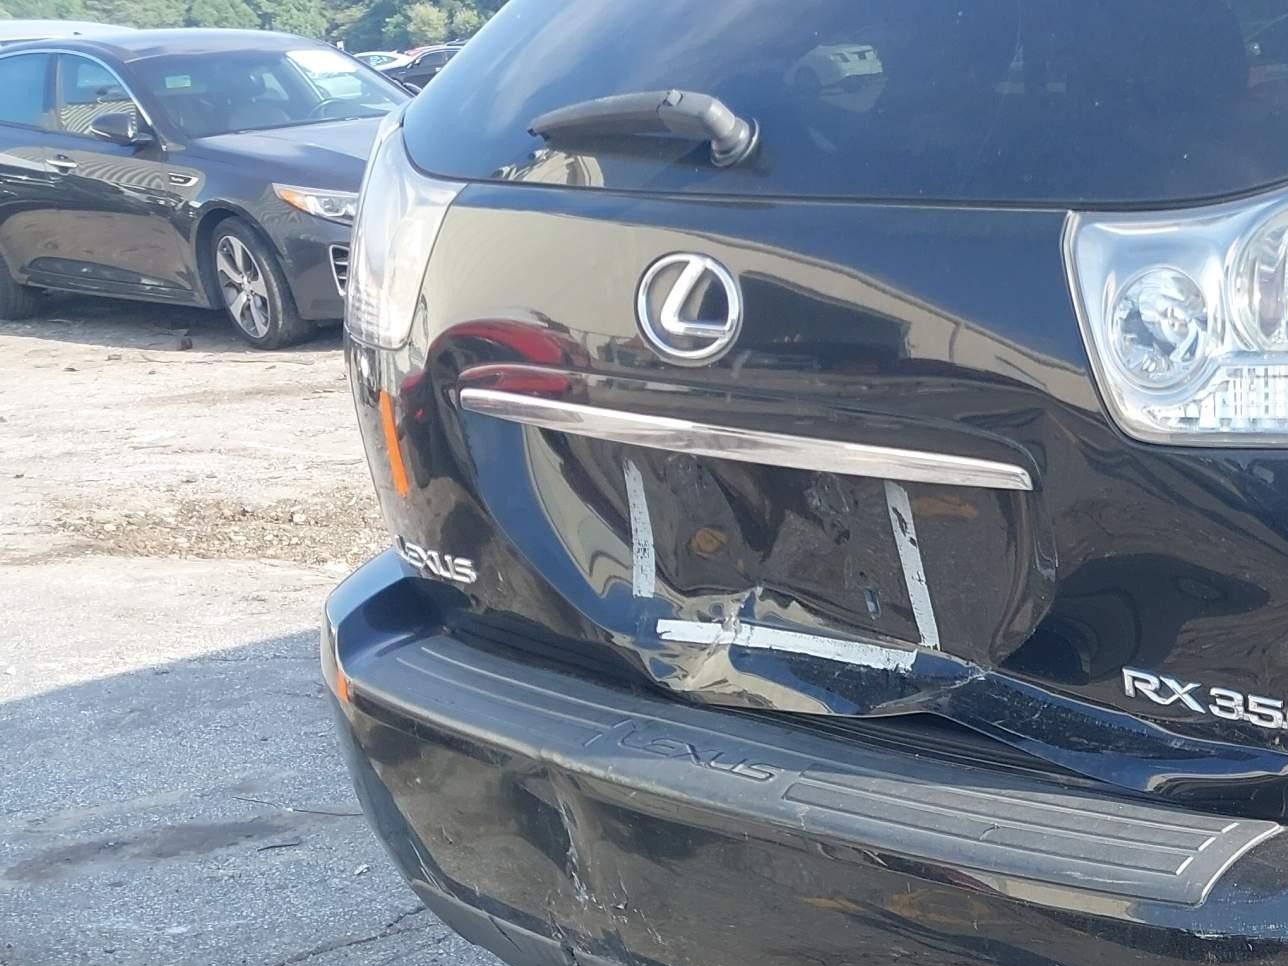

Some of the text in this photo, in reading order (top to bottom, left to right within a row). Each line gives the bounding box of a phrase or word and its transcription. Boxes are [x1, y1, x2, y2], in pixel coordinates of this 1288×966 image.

[395, 534, 478, 584] LEXUS
[1122, 666, 1206, 714] RX
[617, 719, 776, 783] LEXUS
